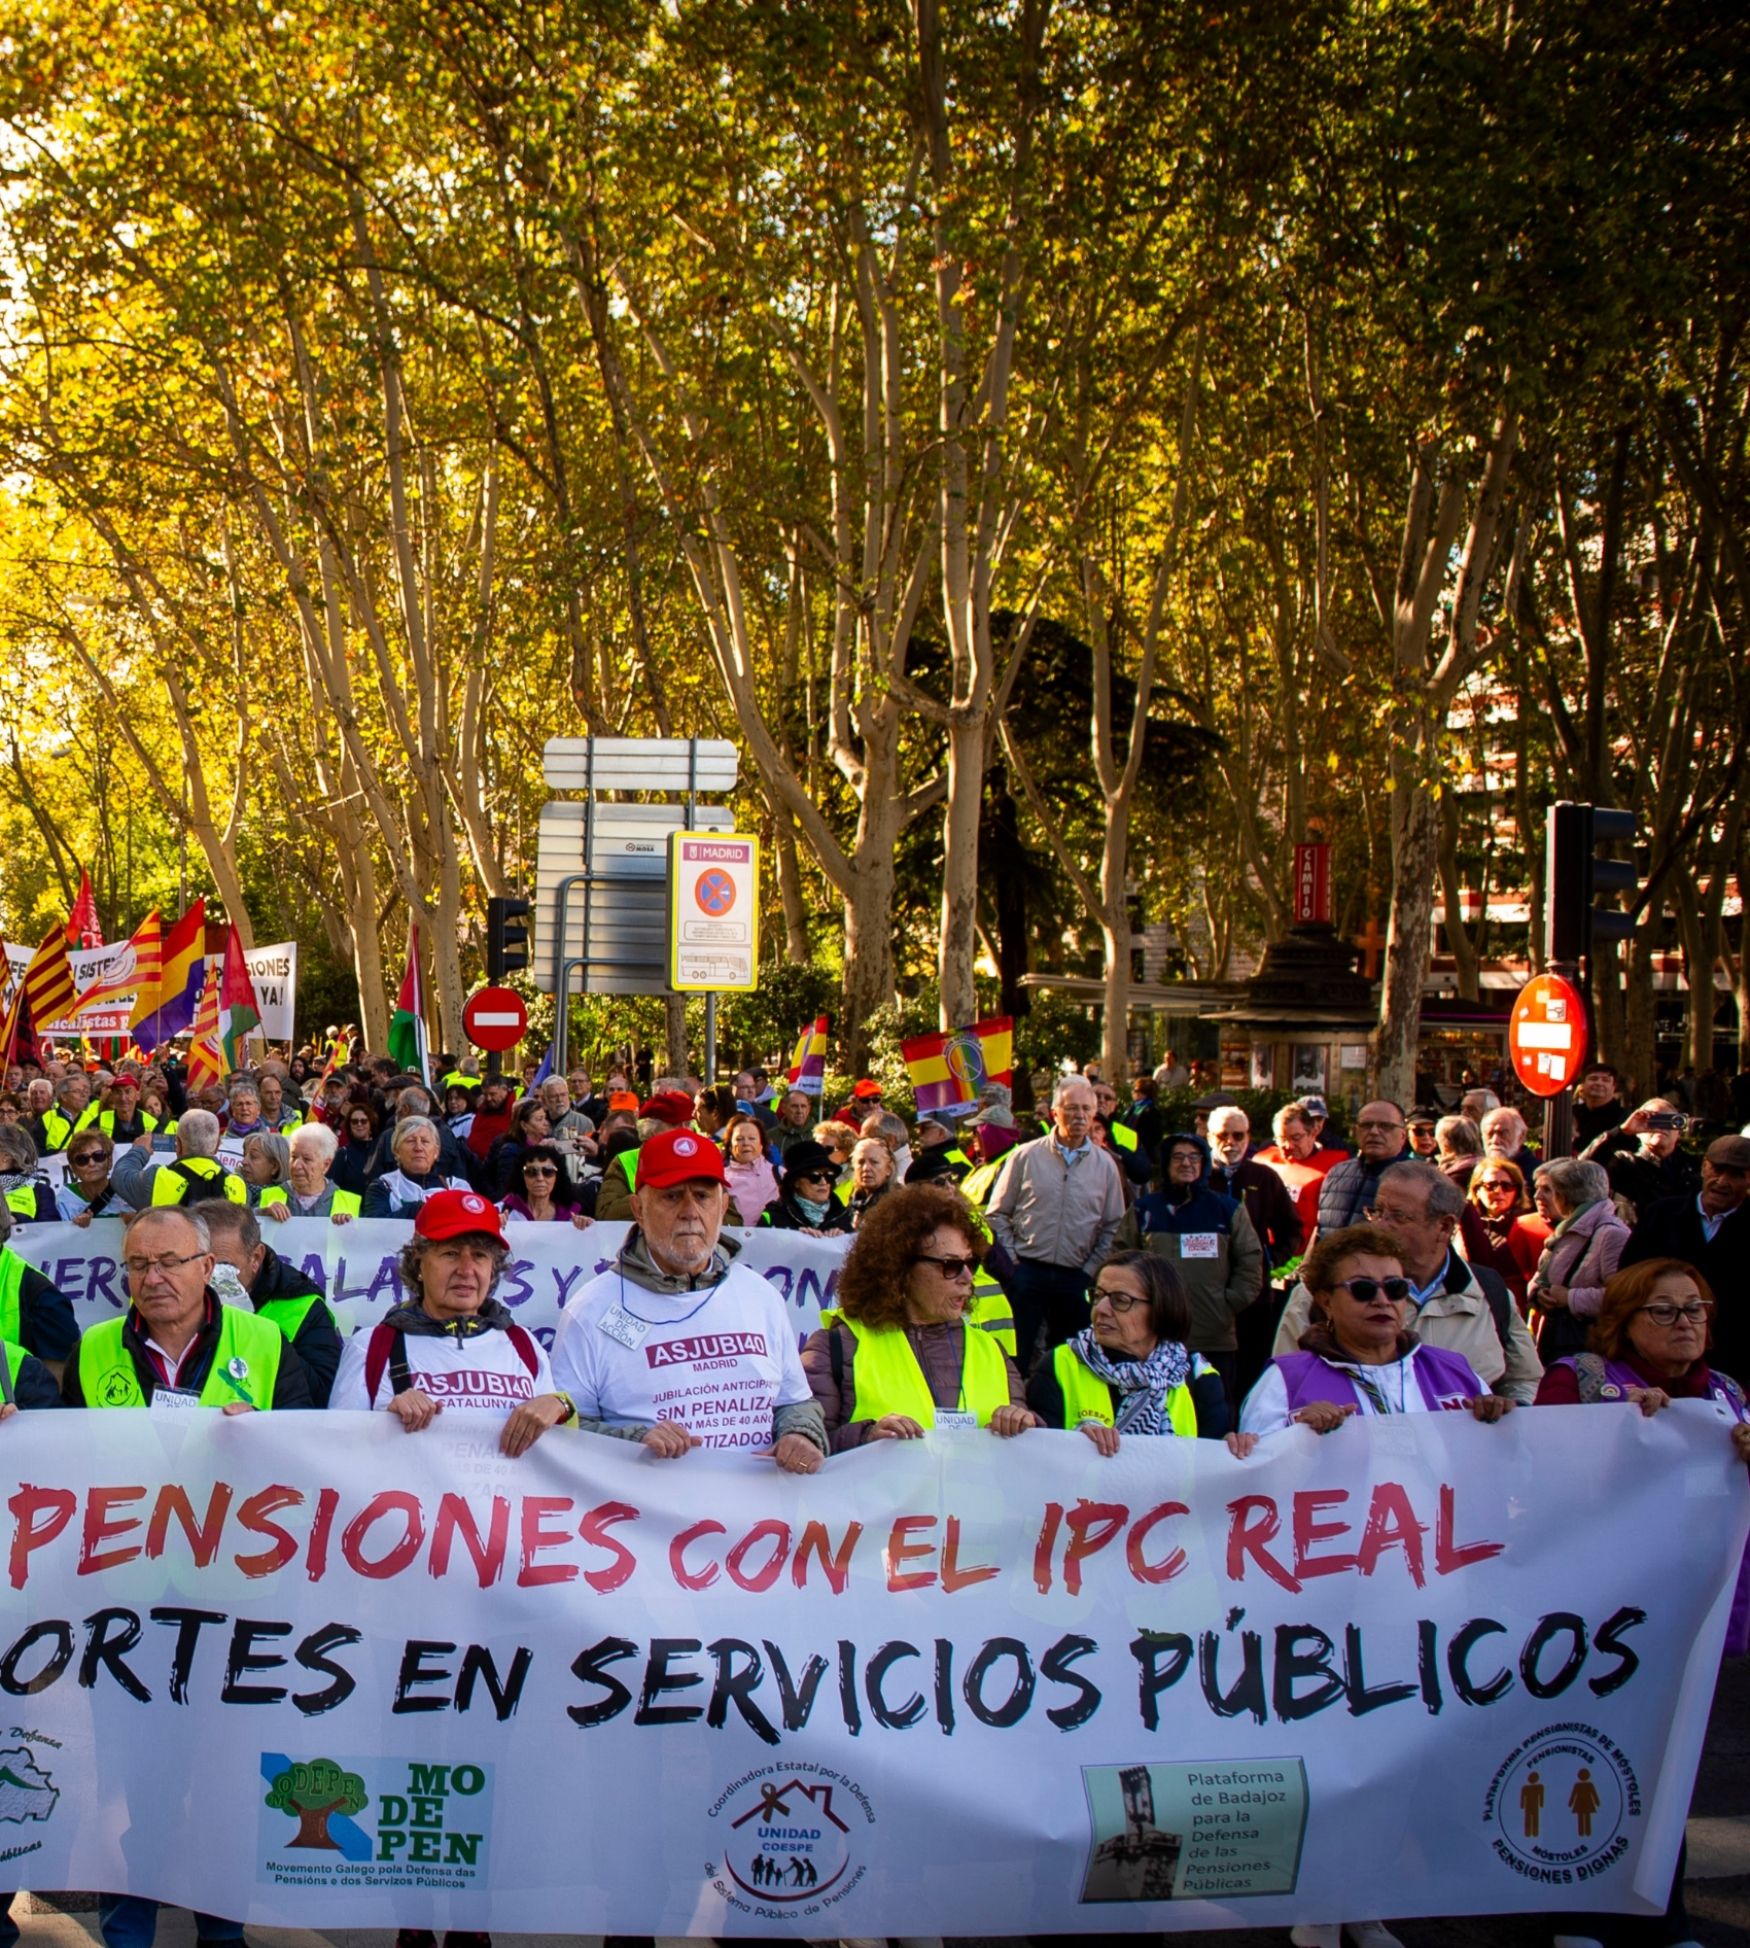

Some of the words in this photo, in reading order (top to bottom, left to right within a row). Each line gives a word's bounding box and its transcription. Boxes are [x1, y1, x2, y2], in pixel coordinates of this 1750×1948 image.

[703, 847, 743, 859] MADRID
[1303, 849, 1313, 918] CAMBIO
[608, 1305, 646, 1333] UNIDAD
[615, 1320, 630, 1332] DE
[599, 1321, 635, 1346] ACCIÓN
[654, 1333, 765, 1365] ASJUBI40
[693, 1358, 738, 1372] MADRID
[413, 1371, 533, 1399] ASJUBI40
[652, 1382, 719, 1404] JUBILACIÓN
[722, 1379, 773, 1392] ANTICIPA
[154, 1392, 196, 1408] UNIDAD
[656, 1404, 686, 1422] SIN
[692, 1396, 774, 1416] PENALIZA
[695, 1417, 719, 1429] MÁS
[722, 1416, 736, 1426] DE
[738, 1415, 750, 1424] 40
[936, 1415, 975, 1425] UNIDAD
[704, 1431, 772, 1449] TIZADOS
[7, 1480, 641, 1596] PENSIONES
[668, 1517, 865, 1596] CON
[884, 1513, 1002, 1595] EL
[1031, 1497, 1191, 1598] IPC
[1225, 1482, 1506, 1595] REAL
[392, 1638, 533, 1723] EN
[565, 1633, 1102, 1747] SERVICIOS
[1129, 1605, 1648, 1733] PÚBLICOS
[1526, 1745, 1596, 1769] PENSIONISTAS
[1521, 1722, 1599, 1749] PENSIONISTAS
[1597, 1733, 1615, 1750] DE
[1611, 1748, 1641, 1816] MÓSTOLES
[406, 1762, 486, 1797] MO
[1187, 1771, 1285, 1787] Plataforma
[707, 1765, 775, 1818] Coordinadora
[776, 1761, 819, 1773] Estatal
[818, 1766, 840, 1781] por
[839, 1774, 850, 1787] la
[848, 1782, 877, 1825] Defensa
[1191, 1793, 1214, 1806] de
[1218, 1790, 1287, 1806] Badajoz
[377, 1794, 444, 1829] DE
[1192, 1814, 1231, 1828] para
[1236, 1810, 1251, 1823] la
[757, 1827, 821, 1840] UNIDAD
[1191, 1828, 1260, 1843] Defensa
[0, 1839, 43, 1863] úblicas
[376, 1829, 484, 1866] PEN
[762, 1842, 814, 1853] COESPE
[1188, 1847, 1211, 1859] de
[1214, 1845, 1238, 1858] las
[1531, 1844, 1590, 1862] MÓSTOLES
[1186, 1859, 1272, 1875] Pensiones
[1492, 1838, 1574, 1884] PENSIONES
[1576, 1836, 1630, 1881] DIGNAS
[266, 1861, 332, 1875] Movemento
[335, 1864, 375, 1878] Galego
[378, 1864, 403, 1878] pola
[406, 1864, 452, 1877] Defensa
[455, 1866, 476, 1878] das
[274, 1873, 327, 1886] Pensións
[330, 1876, 338, 1886] e
[340, 1874, 362, 1886] dos
[364, 1875, 413, 1887] Servizos
[416, 1875, 466, 1889] Públicos
[1183, 1876, 1252, 1891] Públicas
[704, 1861, 720, 1880] del
[713, 1880, 752, 1914] Sistema
[754, 1905, 799, 1920] Público
[803, 1904, 821, 1916] de
[822, 1864, 868, 1909] Pensiones
